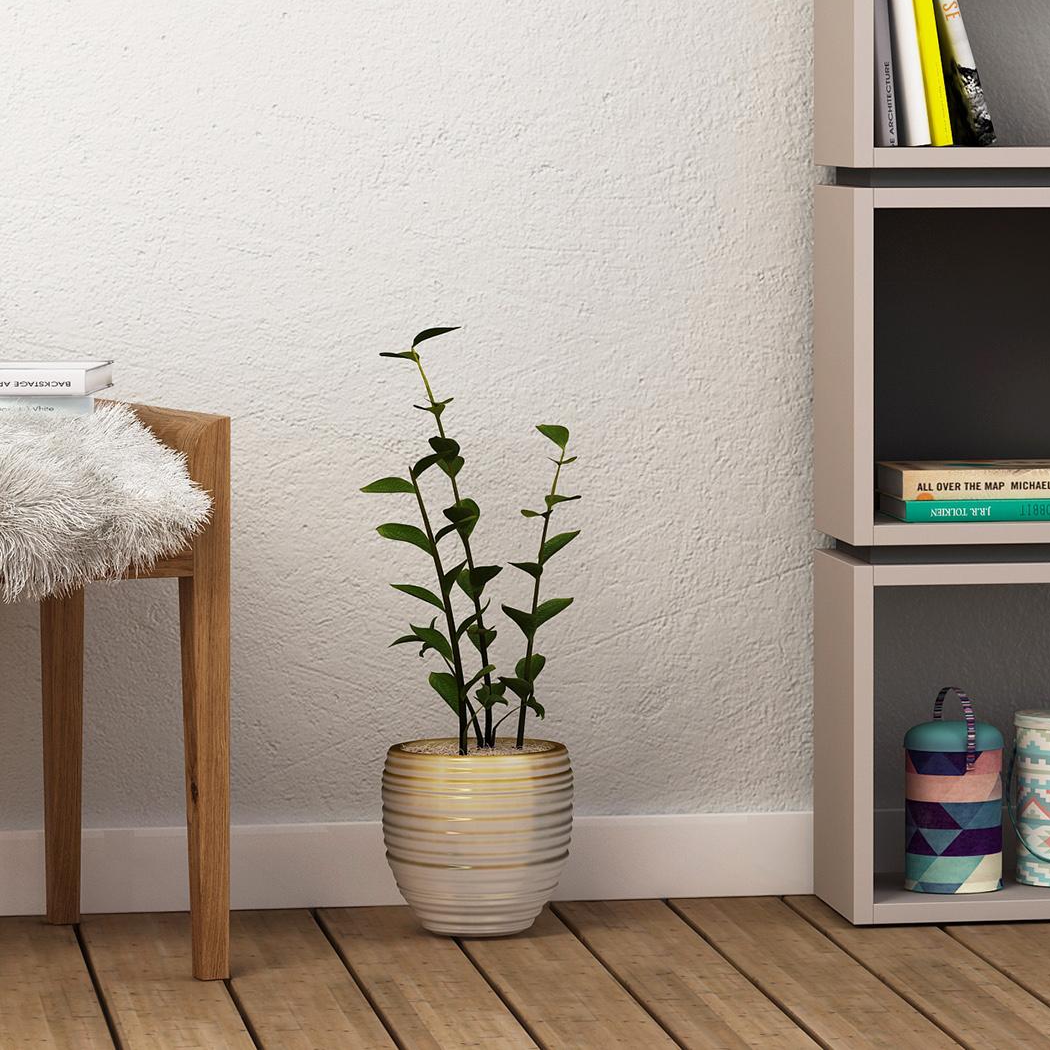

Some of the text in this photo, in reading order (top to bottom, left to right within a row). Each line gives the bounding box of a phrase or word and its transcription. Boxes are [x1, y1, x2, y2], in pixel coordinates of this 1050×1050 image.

[883, 61, 894, 135] ARCHITECTURE
[14, 380, 71, 388] BACKSTAGE
[917, 482, 934, 492] ALL
[936, 482, 961, 491] OVER
[964, 481, 982, 491] THE
[984, 481, 1005, 491] MAP
[930, 506, 968, 517] TOLKIEN
[969, 506, 992, 517] J.R.R.
